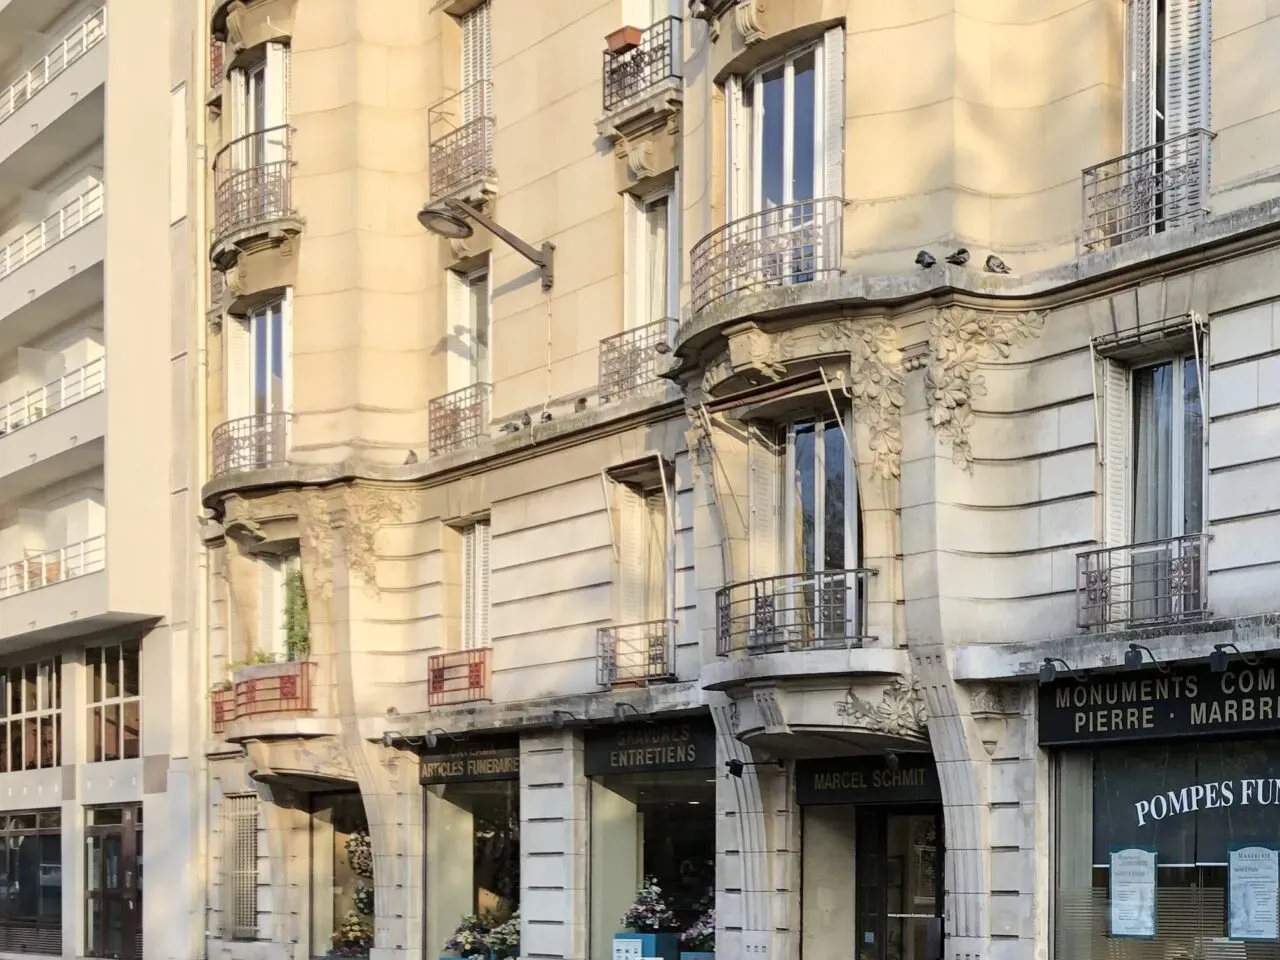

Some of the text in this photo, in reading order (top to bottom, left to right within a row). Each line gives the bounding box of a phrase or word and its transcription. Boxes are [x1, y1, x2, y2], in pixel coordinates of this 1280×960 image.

[1055, 675, 1198, 709] MONUMENTS
[1074, 706, 1155, 734] PIERRE
[610, 744, 696, 767] ENTRETIENS
[421, 760, 465, 778] ARTICLES
[814, 767, 927, 790] MARCEL SCHMIT
[1134, 780, 1234, 828] POMPES
